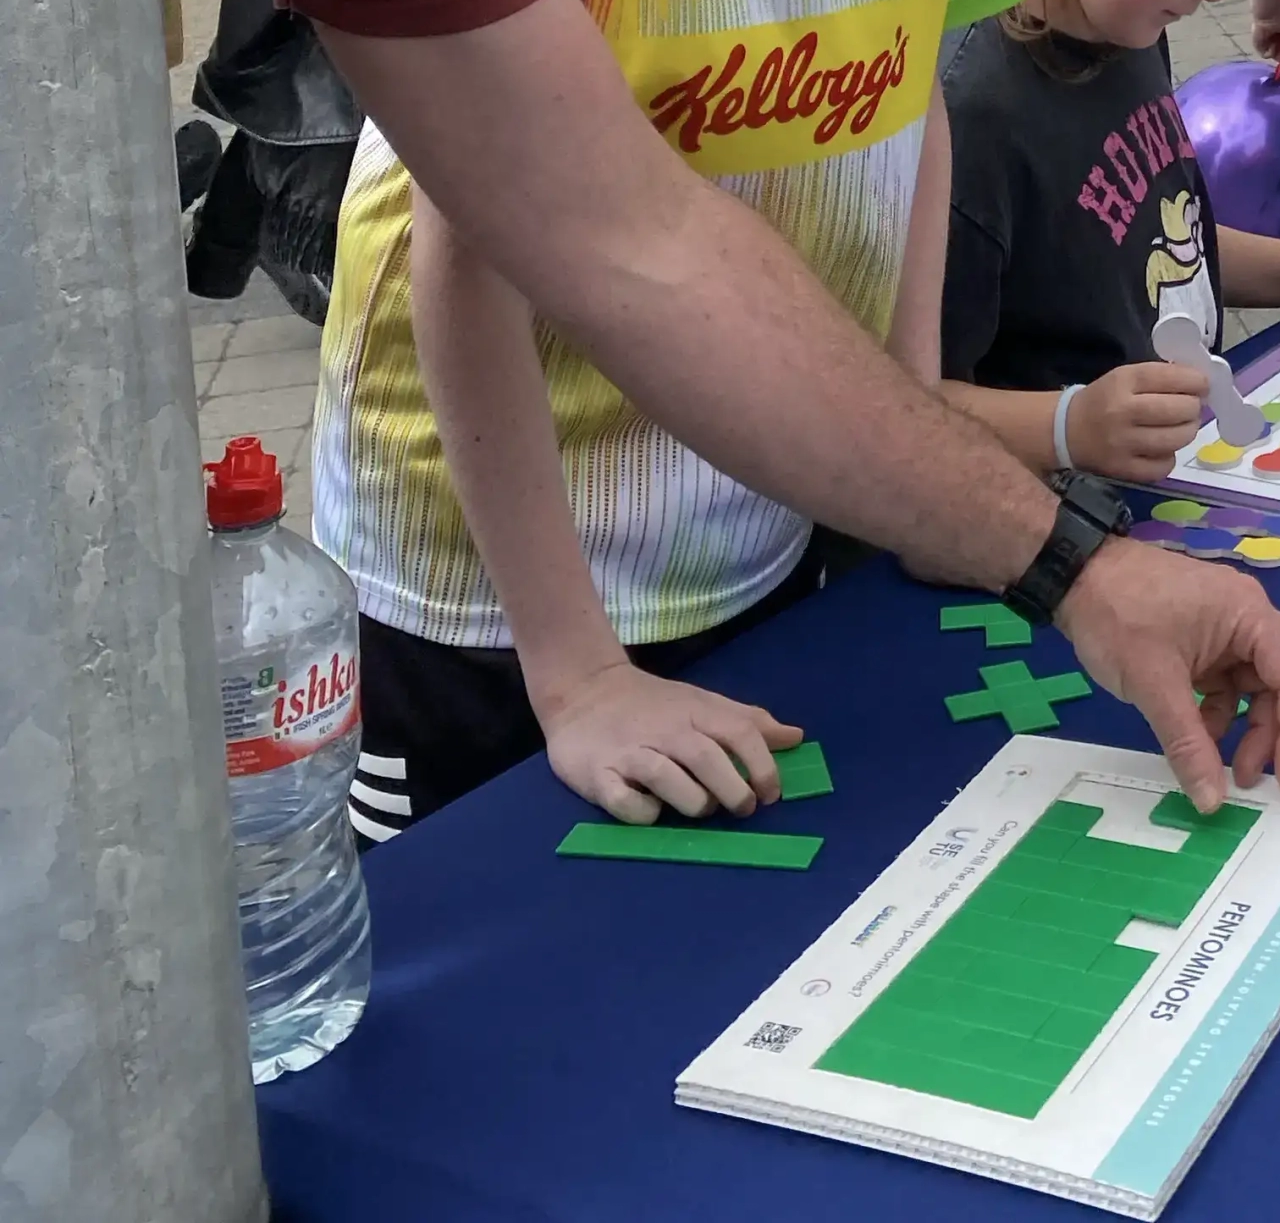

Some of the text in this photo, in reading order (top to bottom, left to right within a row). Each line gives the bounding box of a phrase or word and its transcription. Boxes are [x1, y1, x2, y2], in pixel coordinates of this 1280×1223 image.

[649, 25, 910, 153] Kellogg's
[995, 820, 1019, 838] Can
[927, 841, 951, 857] TU
[942, 843, 965, 859] SE
[976, 835, 1000, 854] you
[969, 853, 989, 866] fill
[954, 864, 978, 881] the
[926, 880, 962, 909] shape
[909, 906, 937, 929] with
[1149, 900, 1252, 1022] PENTOMINOES
